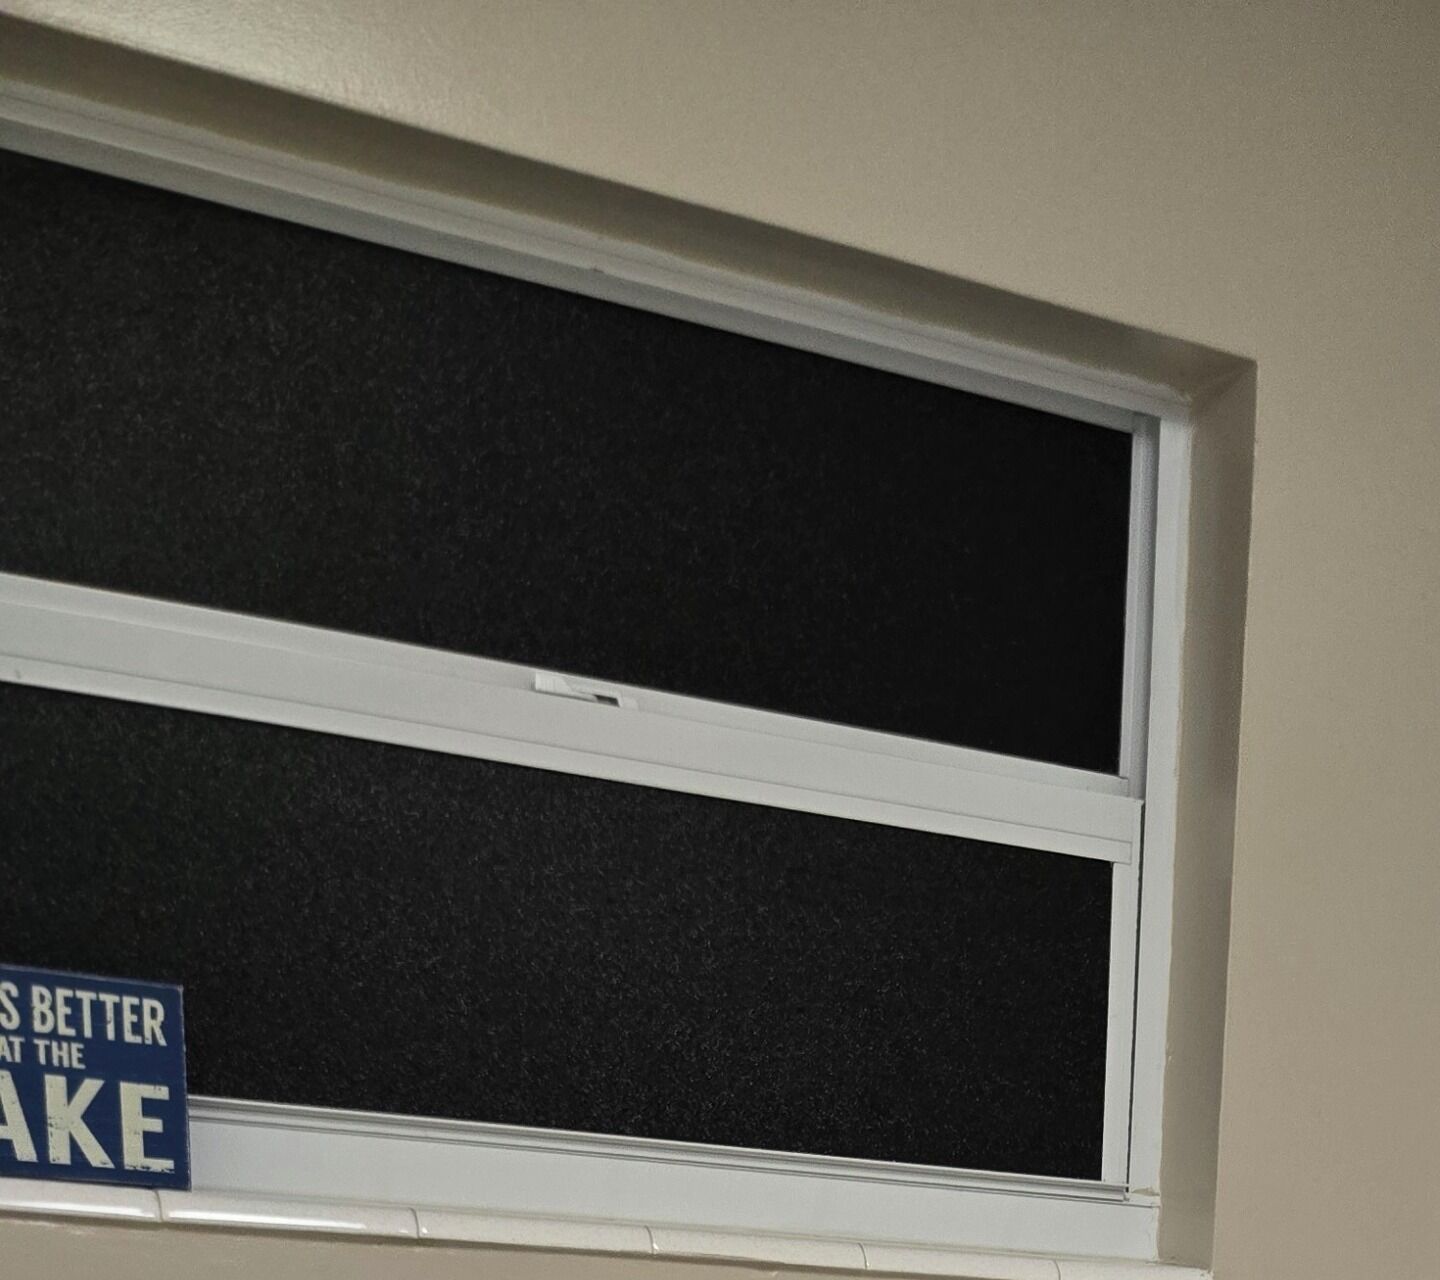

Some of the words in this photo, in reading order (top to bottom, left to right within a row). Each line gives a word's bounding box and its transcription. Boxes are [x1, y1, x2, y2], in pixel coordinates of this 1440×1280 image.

[32, 984, 167, 1047] BETTER
[0, 1035, 25, 1063] AT
[33, 1038, 86, 1070] THE
